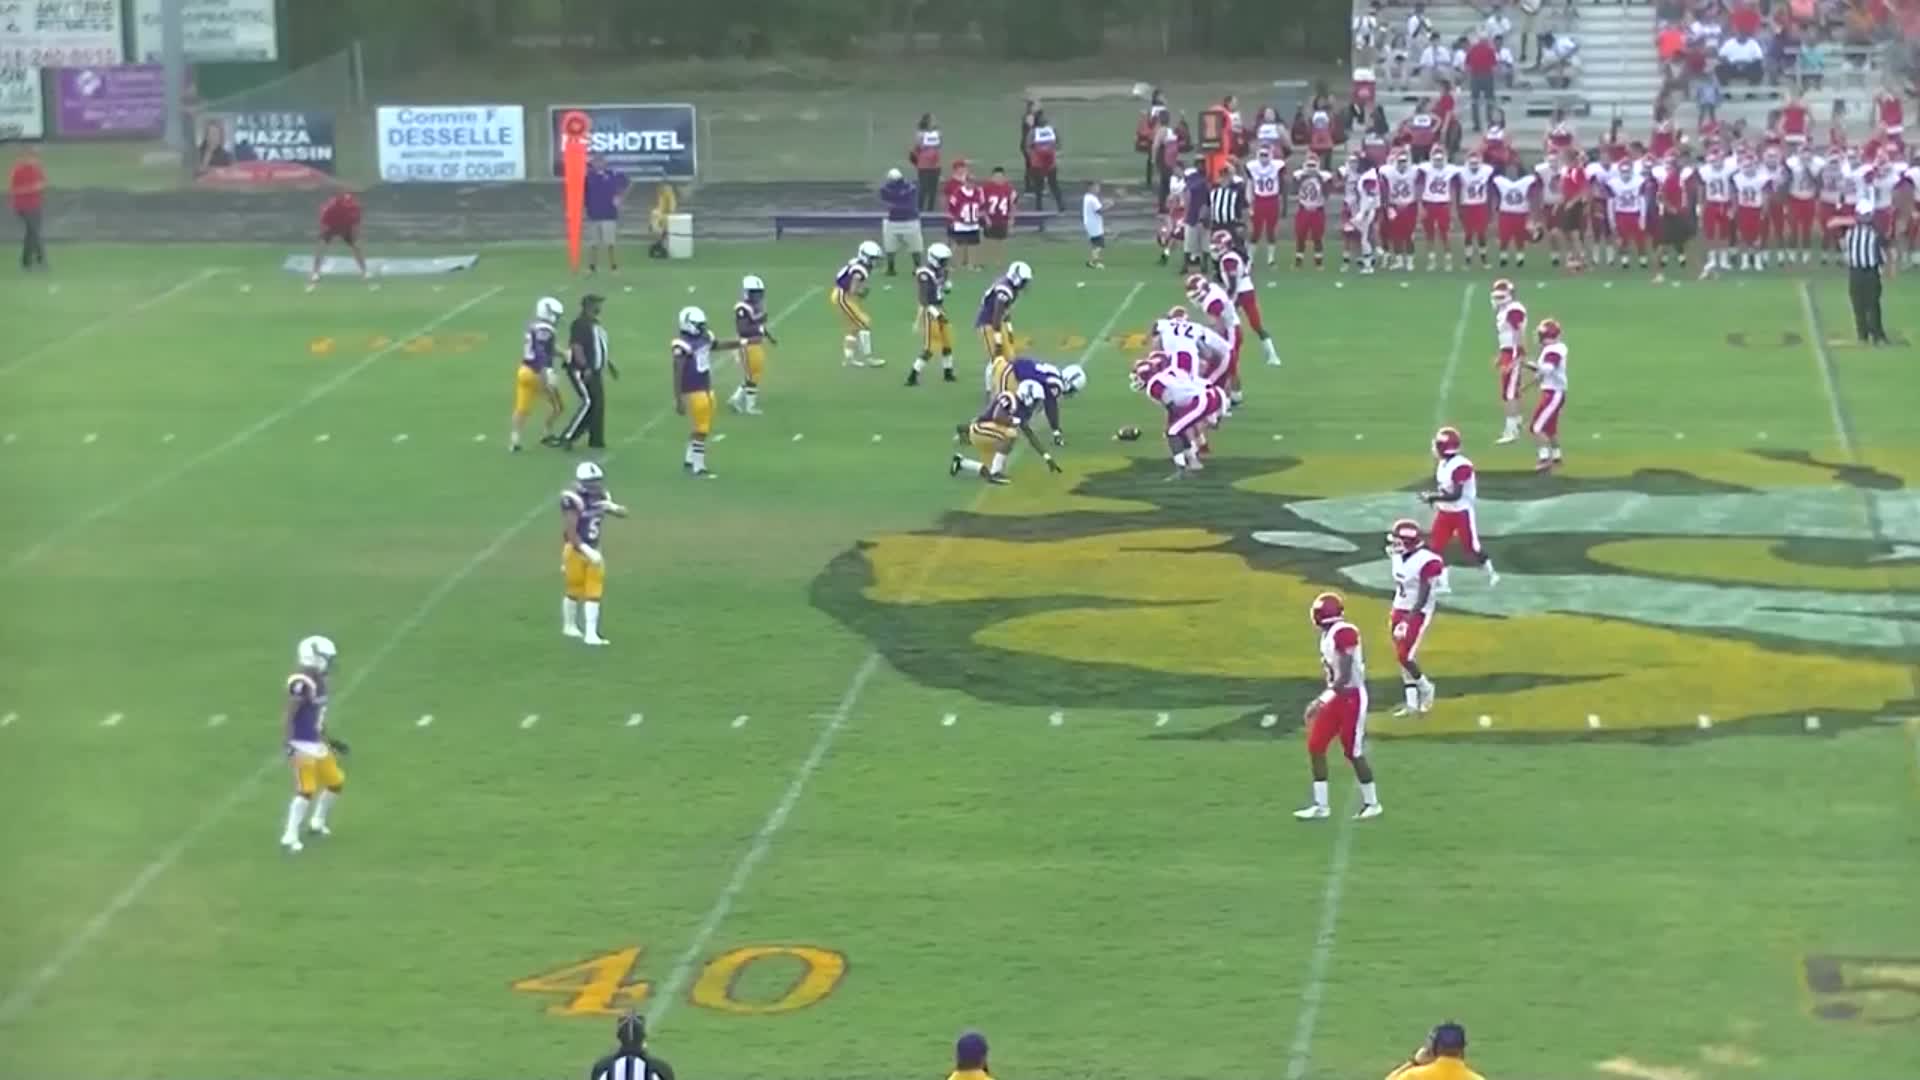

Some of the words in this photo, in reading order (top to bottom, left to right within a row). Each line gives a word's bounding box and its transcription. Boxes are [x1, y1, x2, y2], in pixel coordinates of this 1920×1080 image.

[234, 130, 311, 145] PIAZZA
[387, 126, 513, 147] DESSELLE
[254, 146, 332, 161] TASSIN
[988, 196, 1008, 215] 74
[587, 516, 601, 540] 5
[513, 945, 848, 1017] 40
